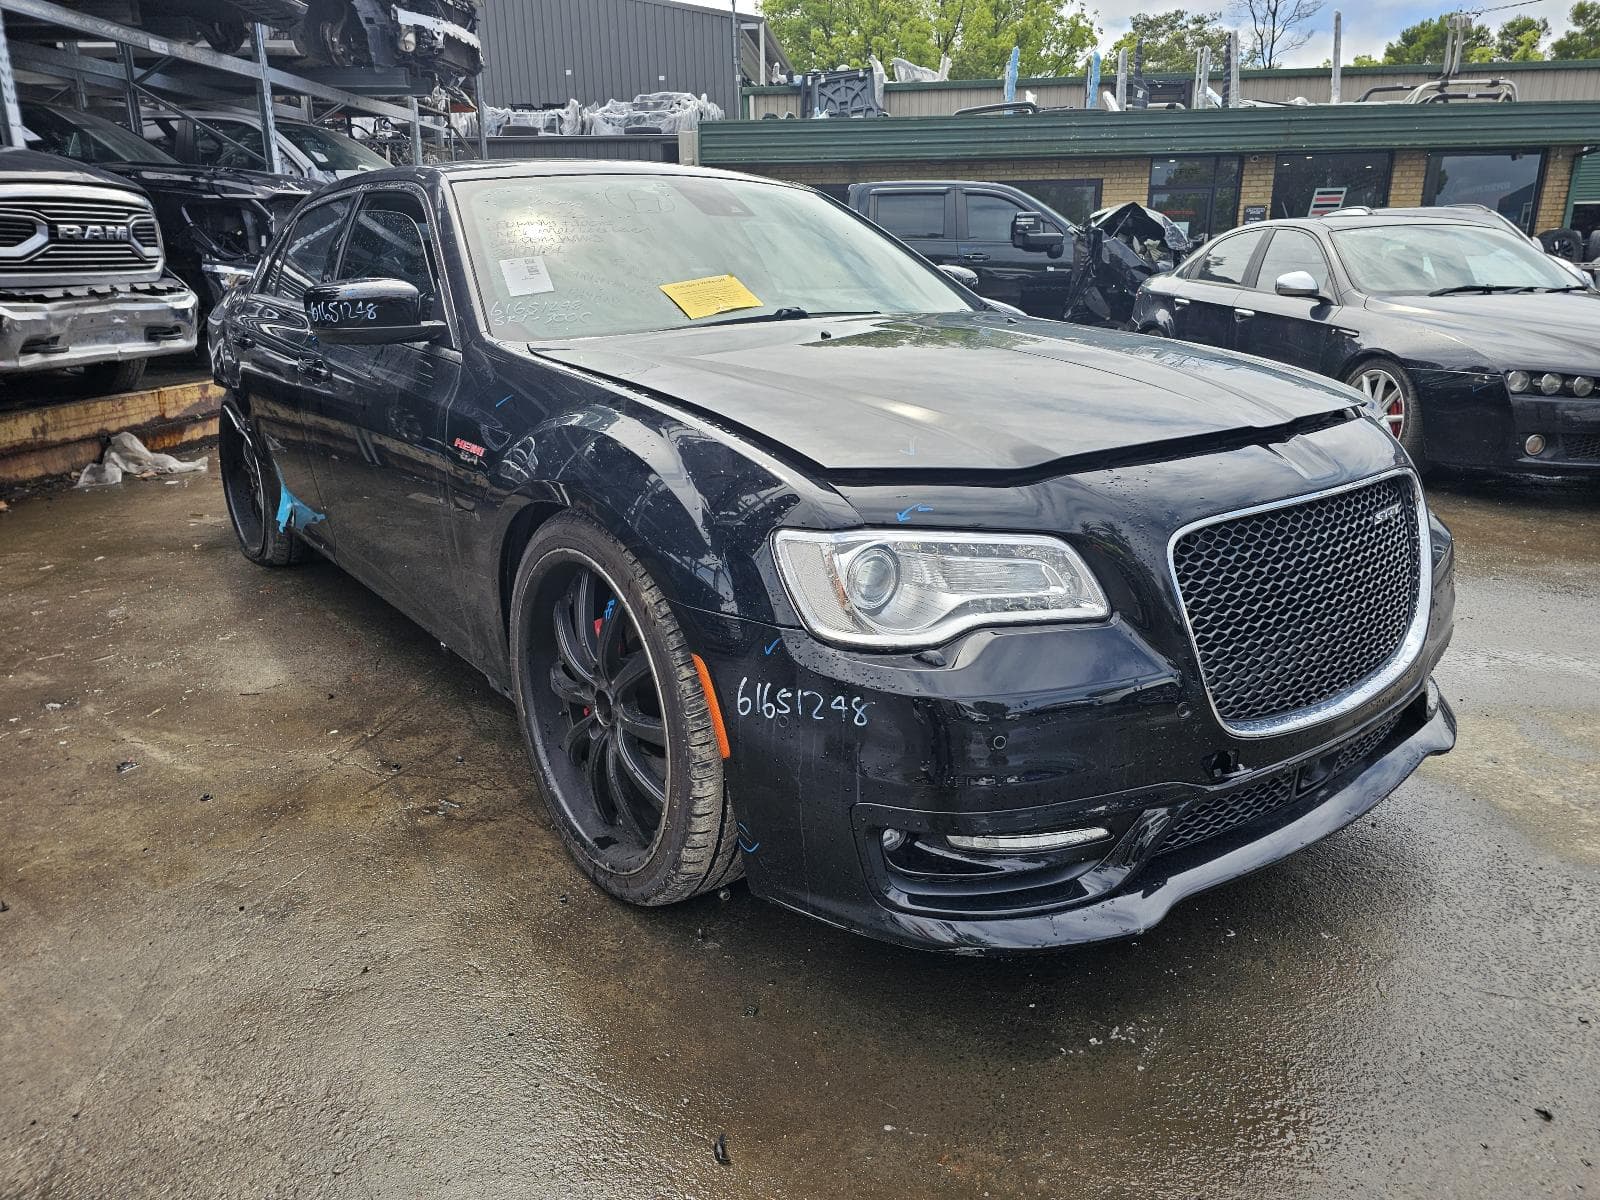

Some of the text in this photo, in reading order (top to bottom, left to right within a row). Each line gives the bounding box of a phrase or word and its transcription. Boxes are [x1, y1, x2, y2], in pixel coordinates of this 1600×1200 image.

[1166, 168, 1201, 176] OFFICE
[57, 224, 129, 241] RAM
[737, 676, 876, 727] 61651248
